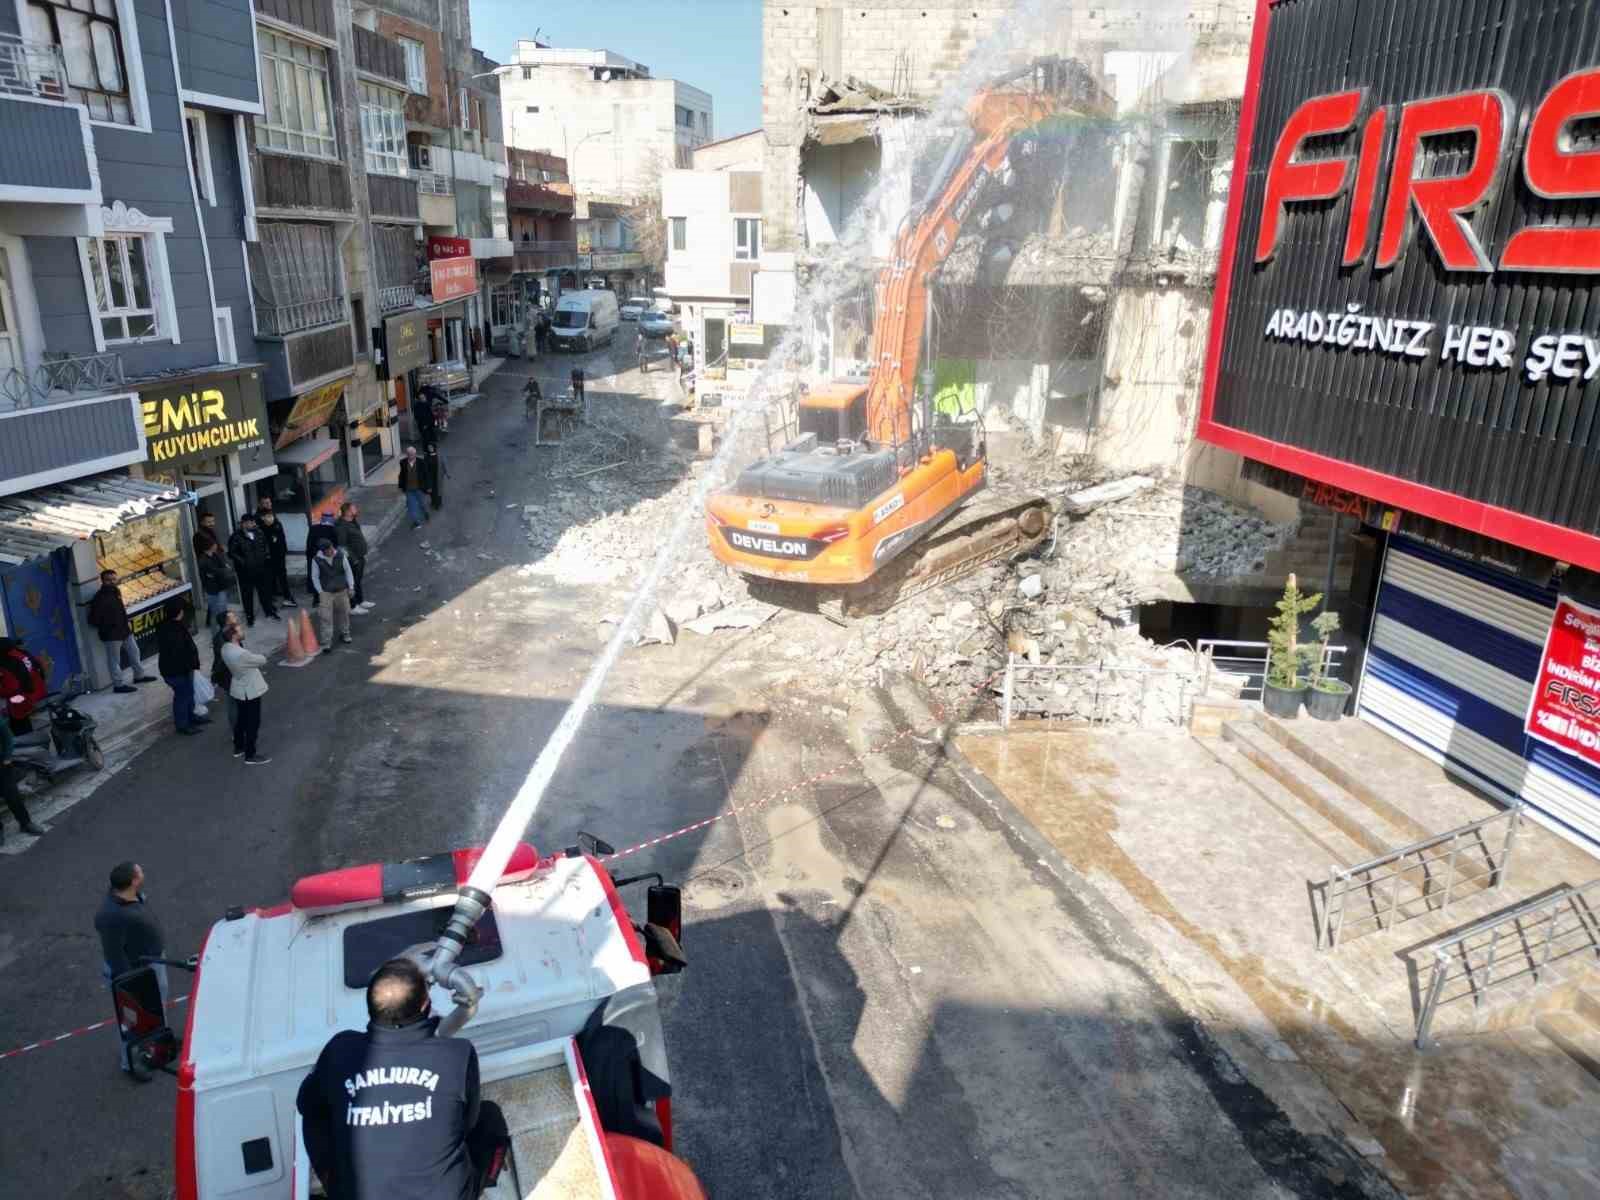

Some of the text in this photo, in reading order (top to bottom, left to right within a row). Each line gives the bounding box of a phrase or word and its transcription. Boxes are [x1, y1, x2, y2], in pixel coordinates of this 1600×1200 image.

[1265, 302, 1434, 357] ARADIĞINIZ
[1440, 325, 1513, 367] HER
[152, 418, 259, 462] KUYUMCULUK
[732, 533, 807, 555] DEVELON
[345, 1066, 440, 1097] ŞANLIURFA
[346, 1096, 432, 1126] İTFAİYESİ
